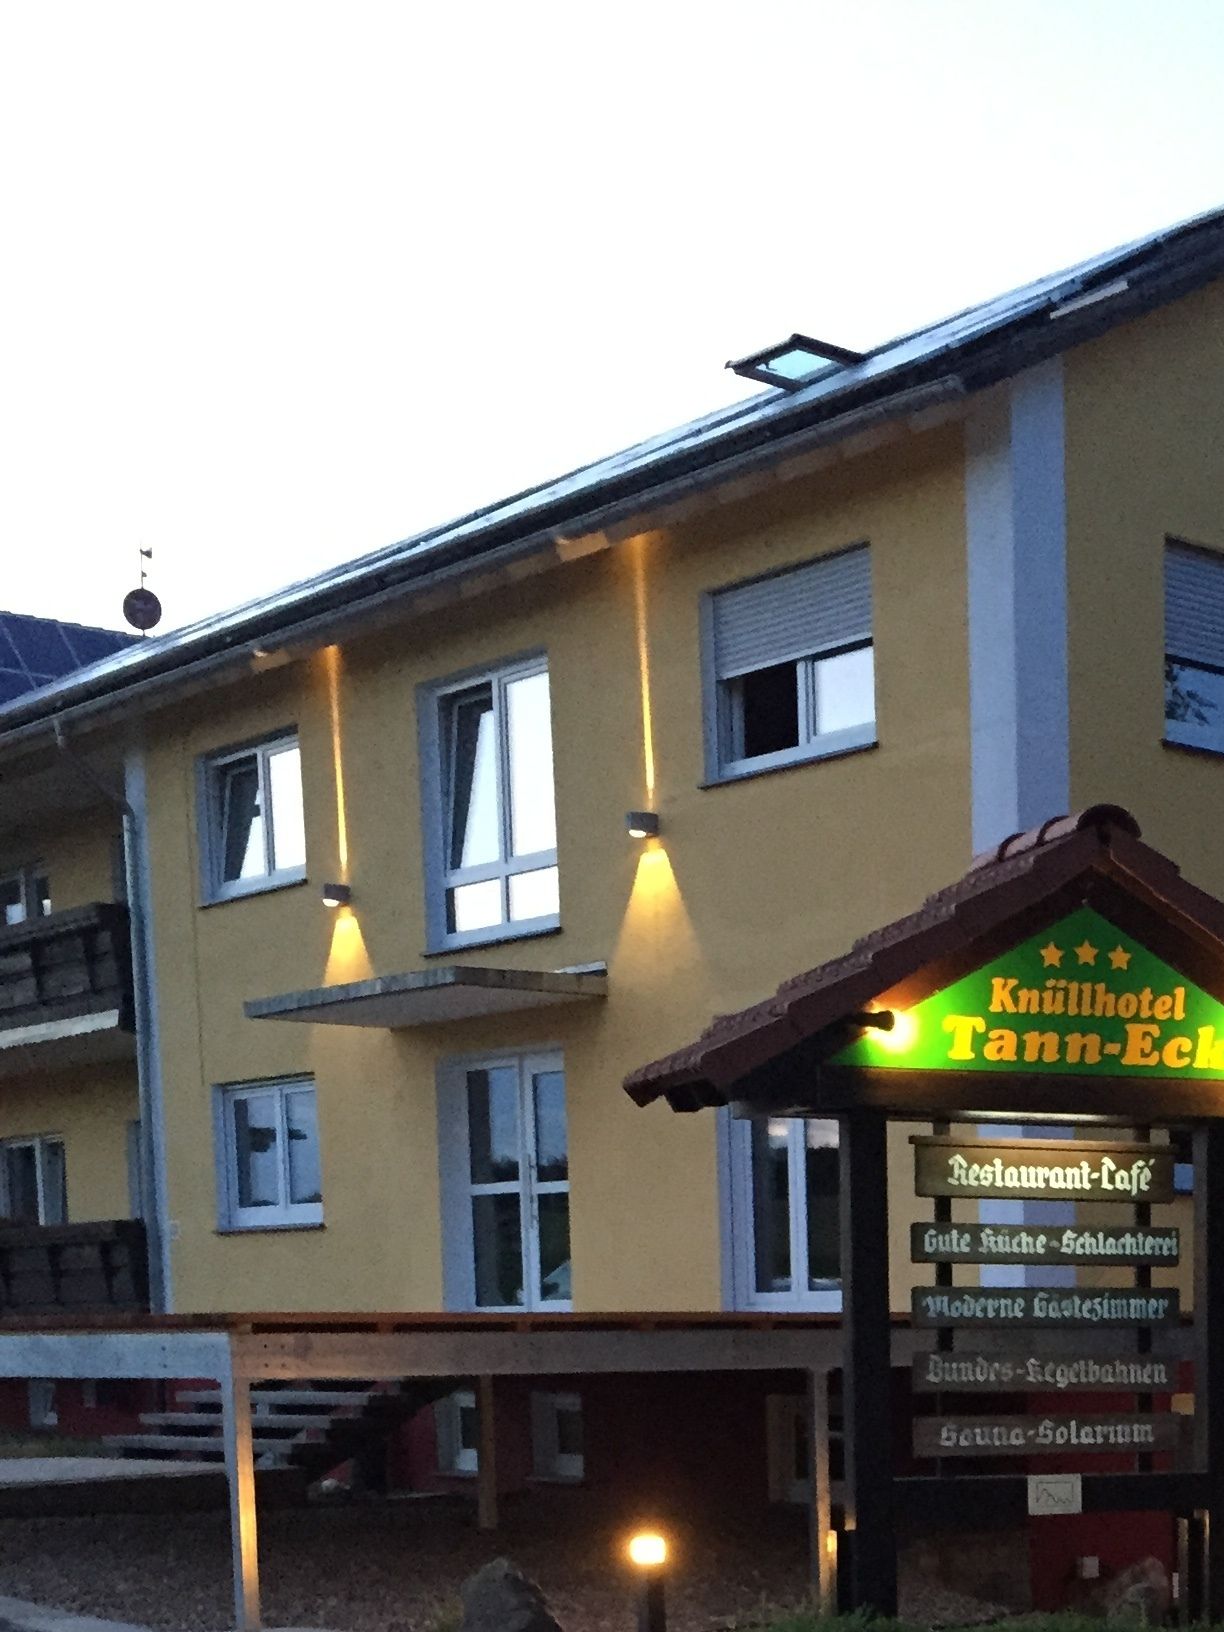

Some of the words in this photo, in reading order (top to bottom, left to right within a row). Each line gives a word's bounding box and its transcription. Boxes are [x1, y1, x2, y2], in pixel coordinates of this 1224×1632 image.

[989, 977, 1186, 1021] Knüllhotel
[948, 1153, 1155, 1196] Restaurant-Café
[923, 1229, 971, 1255] Gute
[922, 1294, 1025, 1319] Moderne
[925, 1355, 1168, 1388] Bundes-Kegelbahnen
[940, 1419, 1155, 1447] Sauna-Solarium
